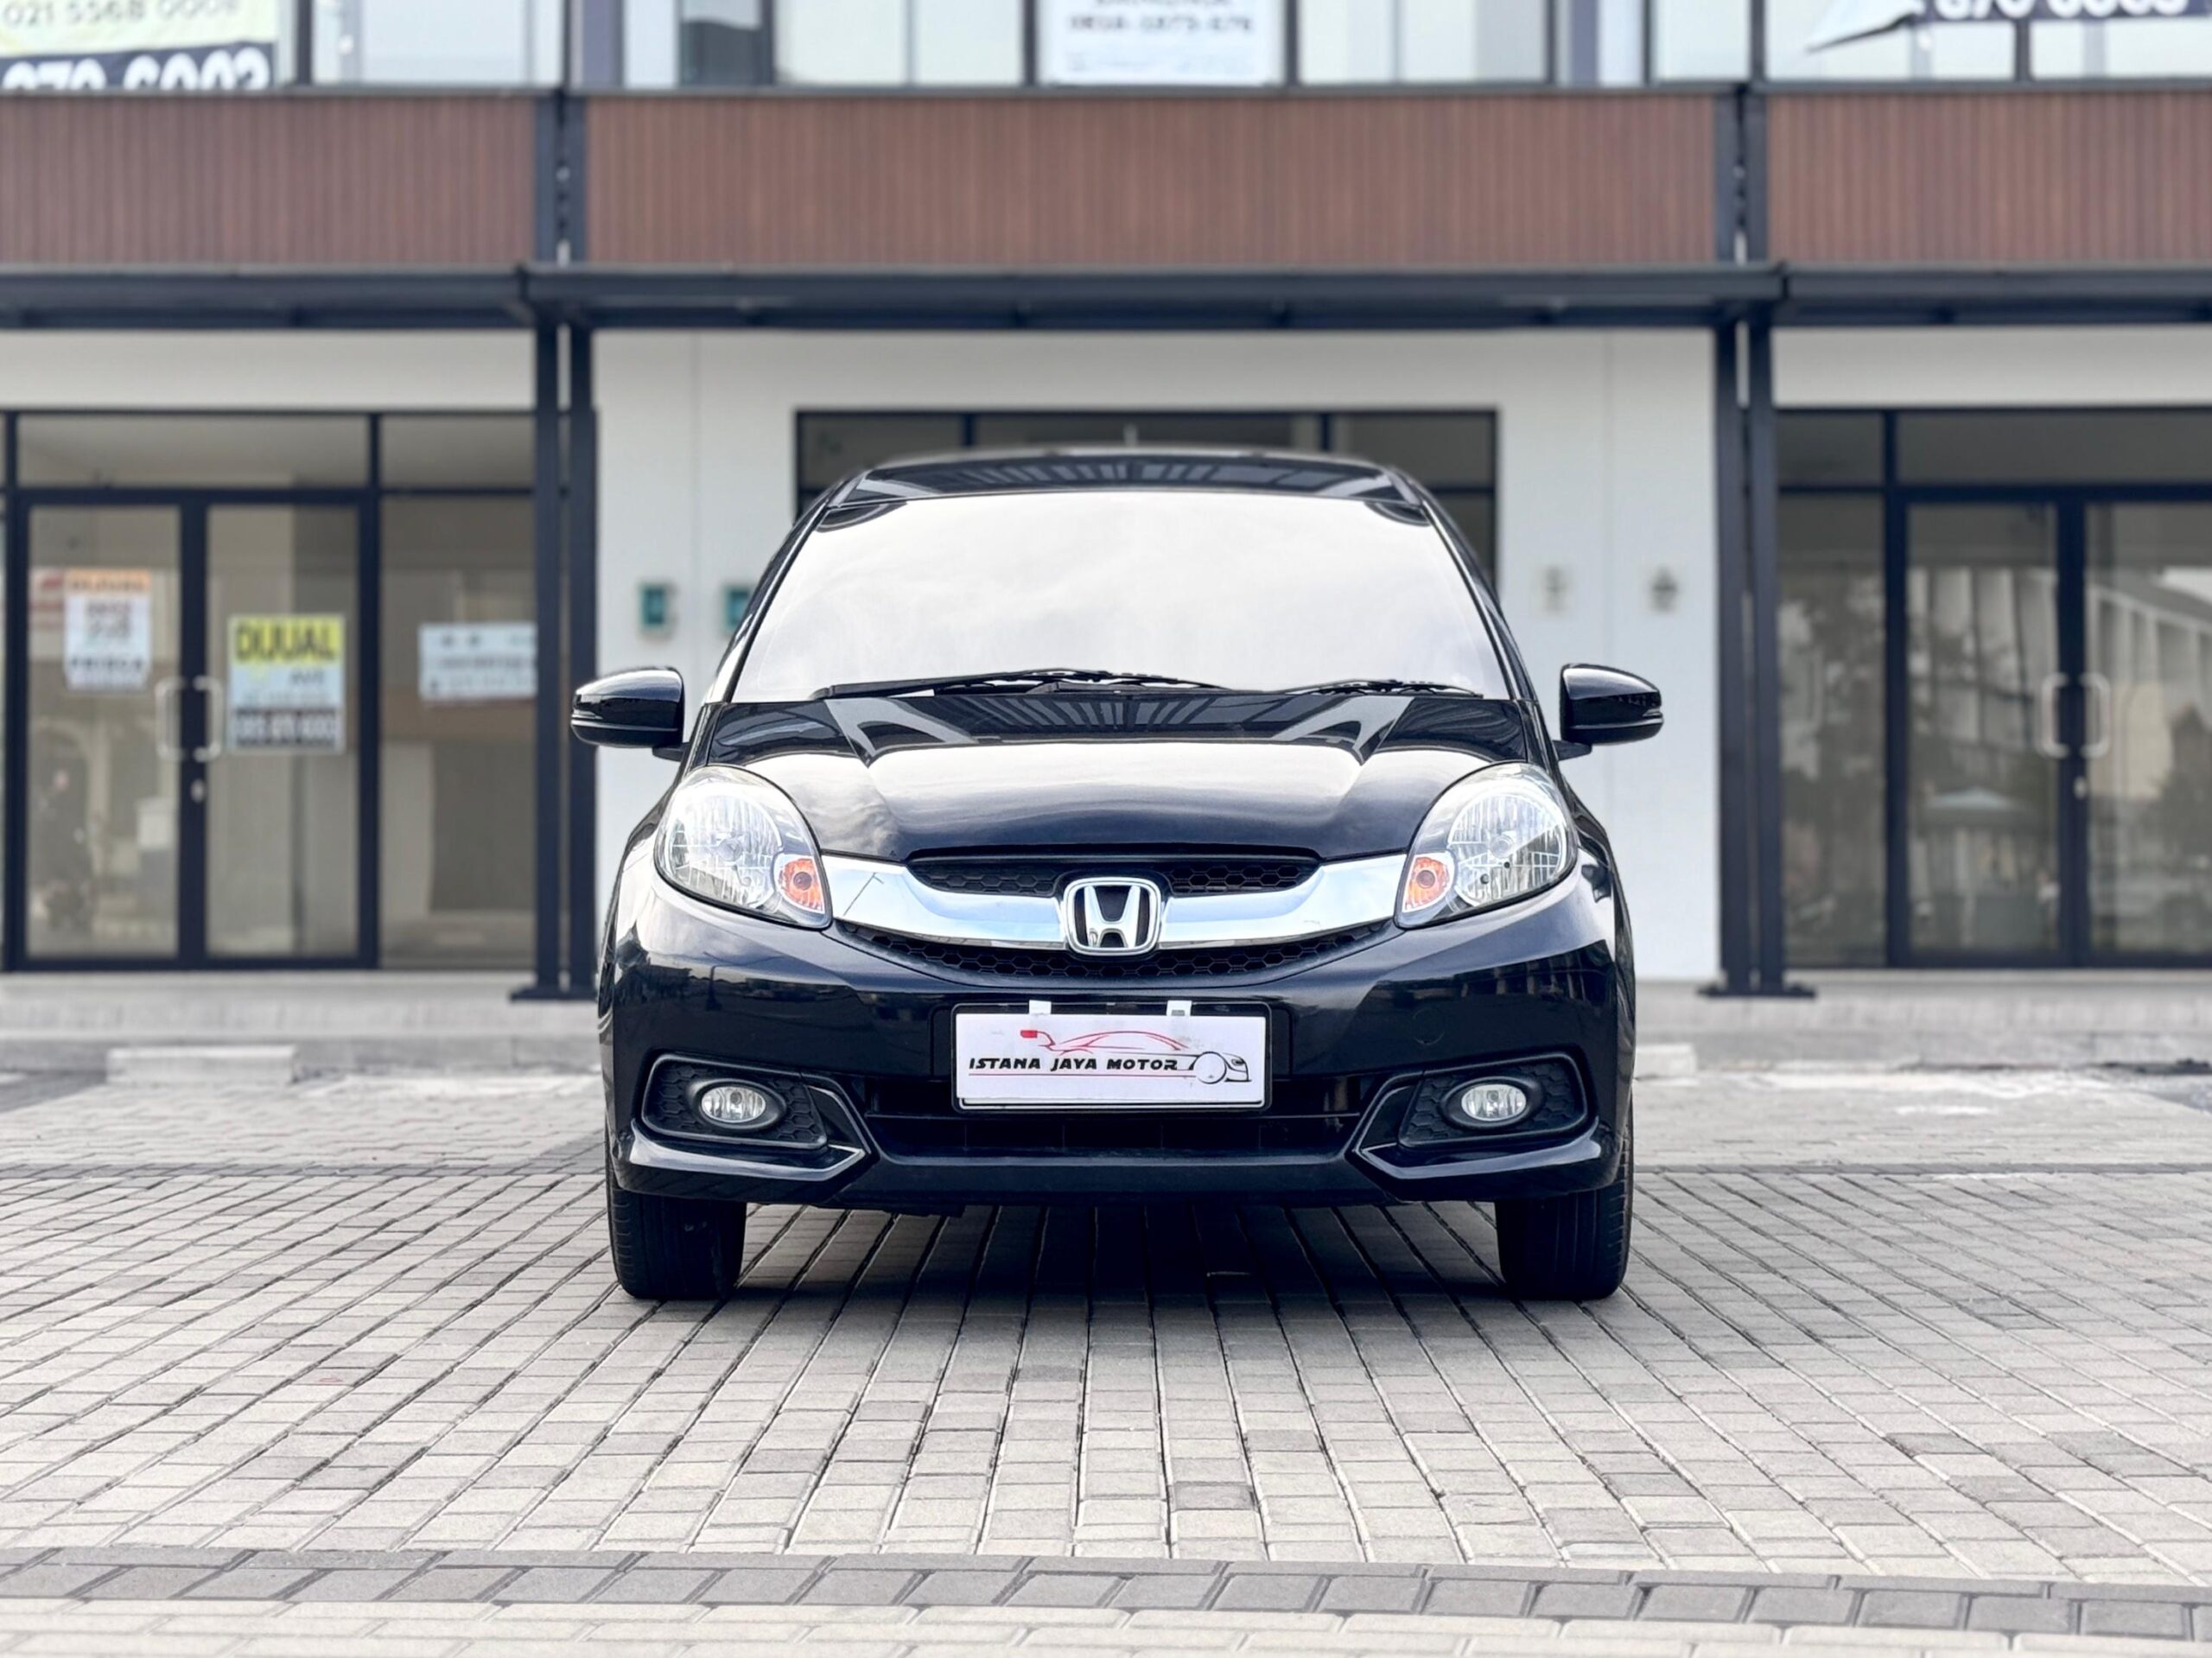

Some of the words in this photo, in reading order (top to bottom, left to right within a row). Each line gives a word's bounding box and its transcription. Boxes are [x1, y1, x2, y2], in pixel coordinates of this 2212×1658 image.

[969, 1057, 1041, 1070] ISTANA
[1050, 1058, 1097, 1072] JAYA
[1106, 1058, 1179, 1071] MOTOR
